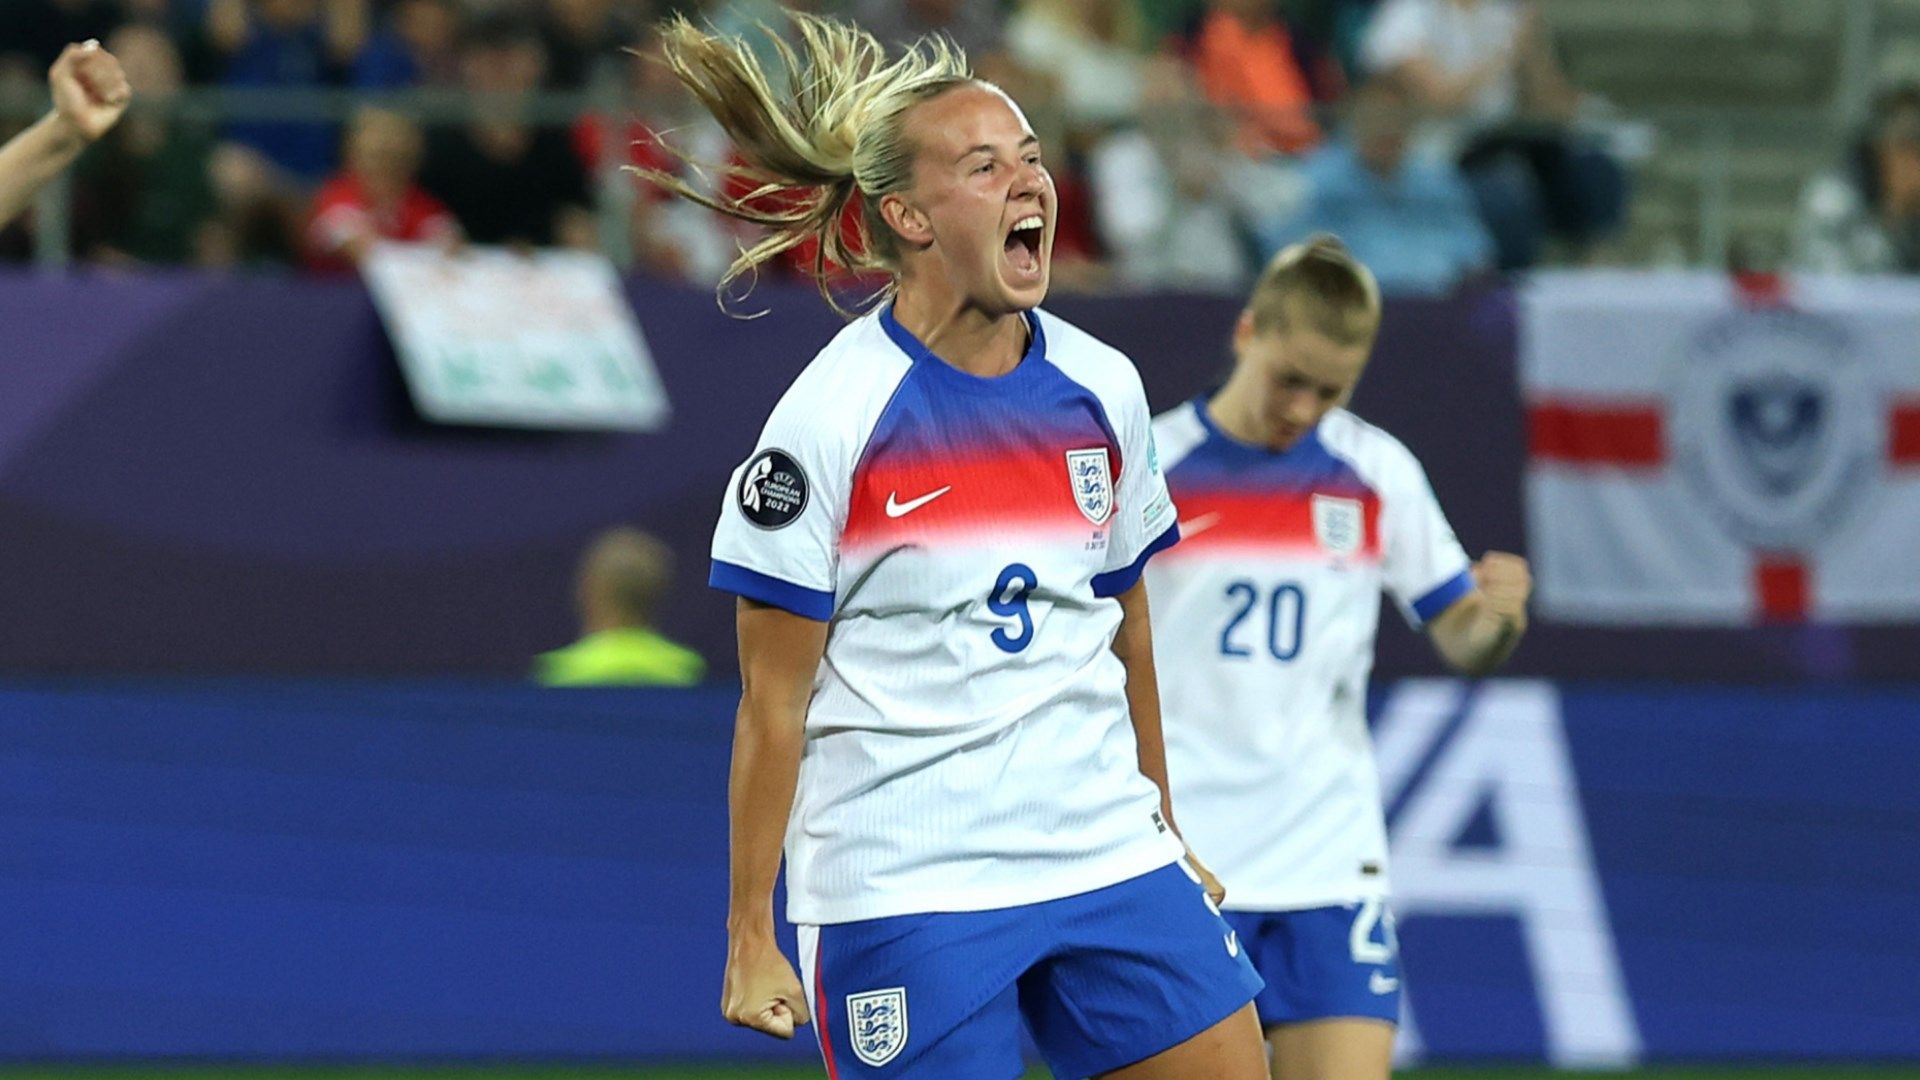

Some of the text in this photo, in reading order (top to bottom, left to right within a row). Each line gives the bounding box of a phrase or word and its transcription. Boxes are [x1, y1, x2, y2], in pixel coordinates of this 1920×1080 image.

[760, 487, 800, 505] CHAMPIONS
[764, 480, 800, 497] EUROPEAN
[766, 498, 789, 512] 2022
[987, 563, 1037, 653] 9
[1221, 580, 1306, 661] 20
